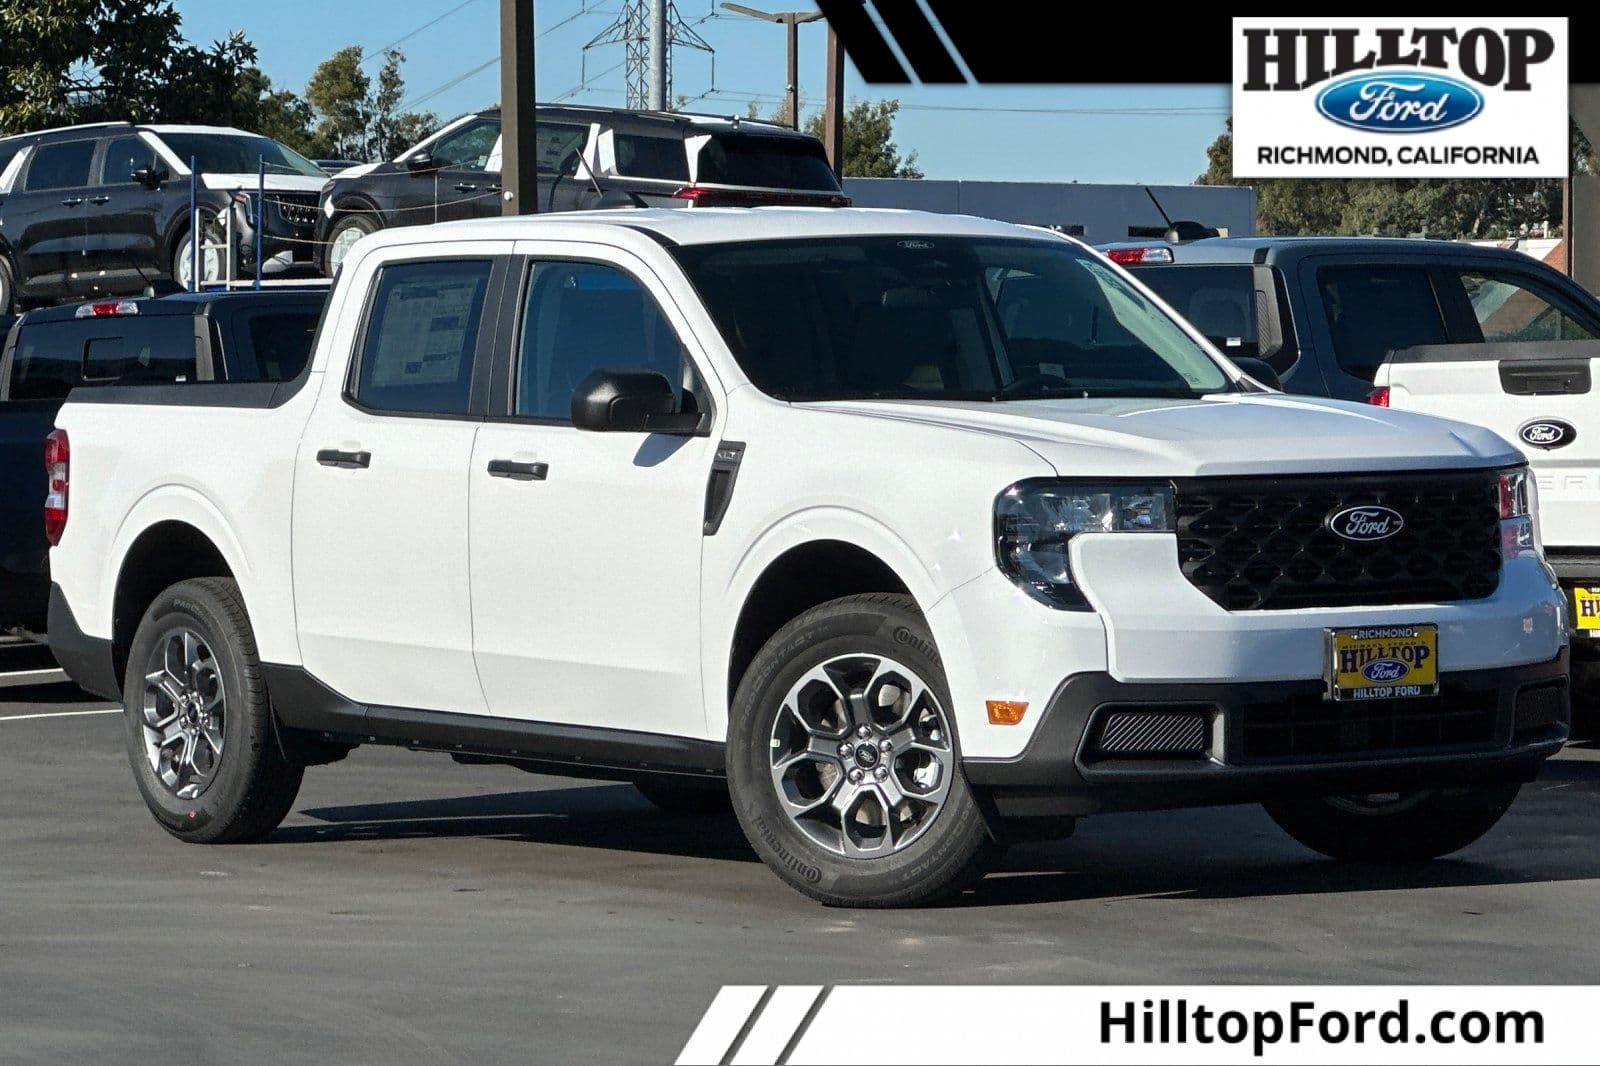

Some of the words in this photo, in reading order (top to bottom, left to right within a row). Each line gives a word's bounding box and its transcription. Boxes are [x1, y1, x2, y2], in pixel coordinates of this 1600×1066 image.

[1529, 426, 1555, 441] Ford
[1346, 510, 1390, 535] Ford
[1359, 628, 1413, 639] RICHMOND
[1340, 645, 1430, 673] HILLTOP
[1370, 662, 1401, 680] Ford
[1352, 687, 1393, 698] HILLTOP
